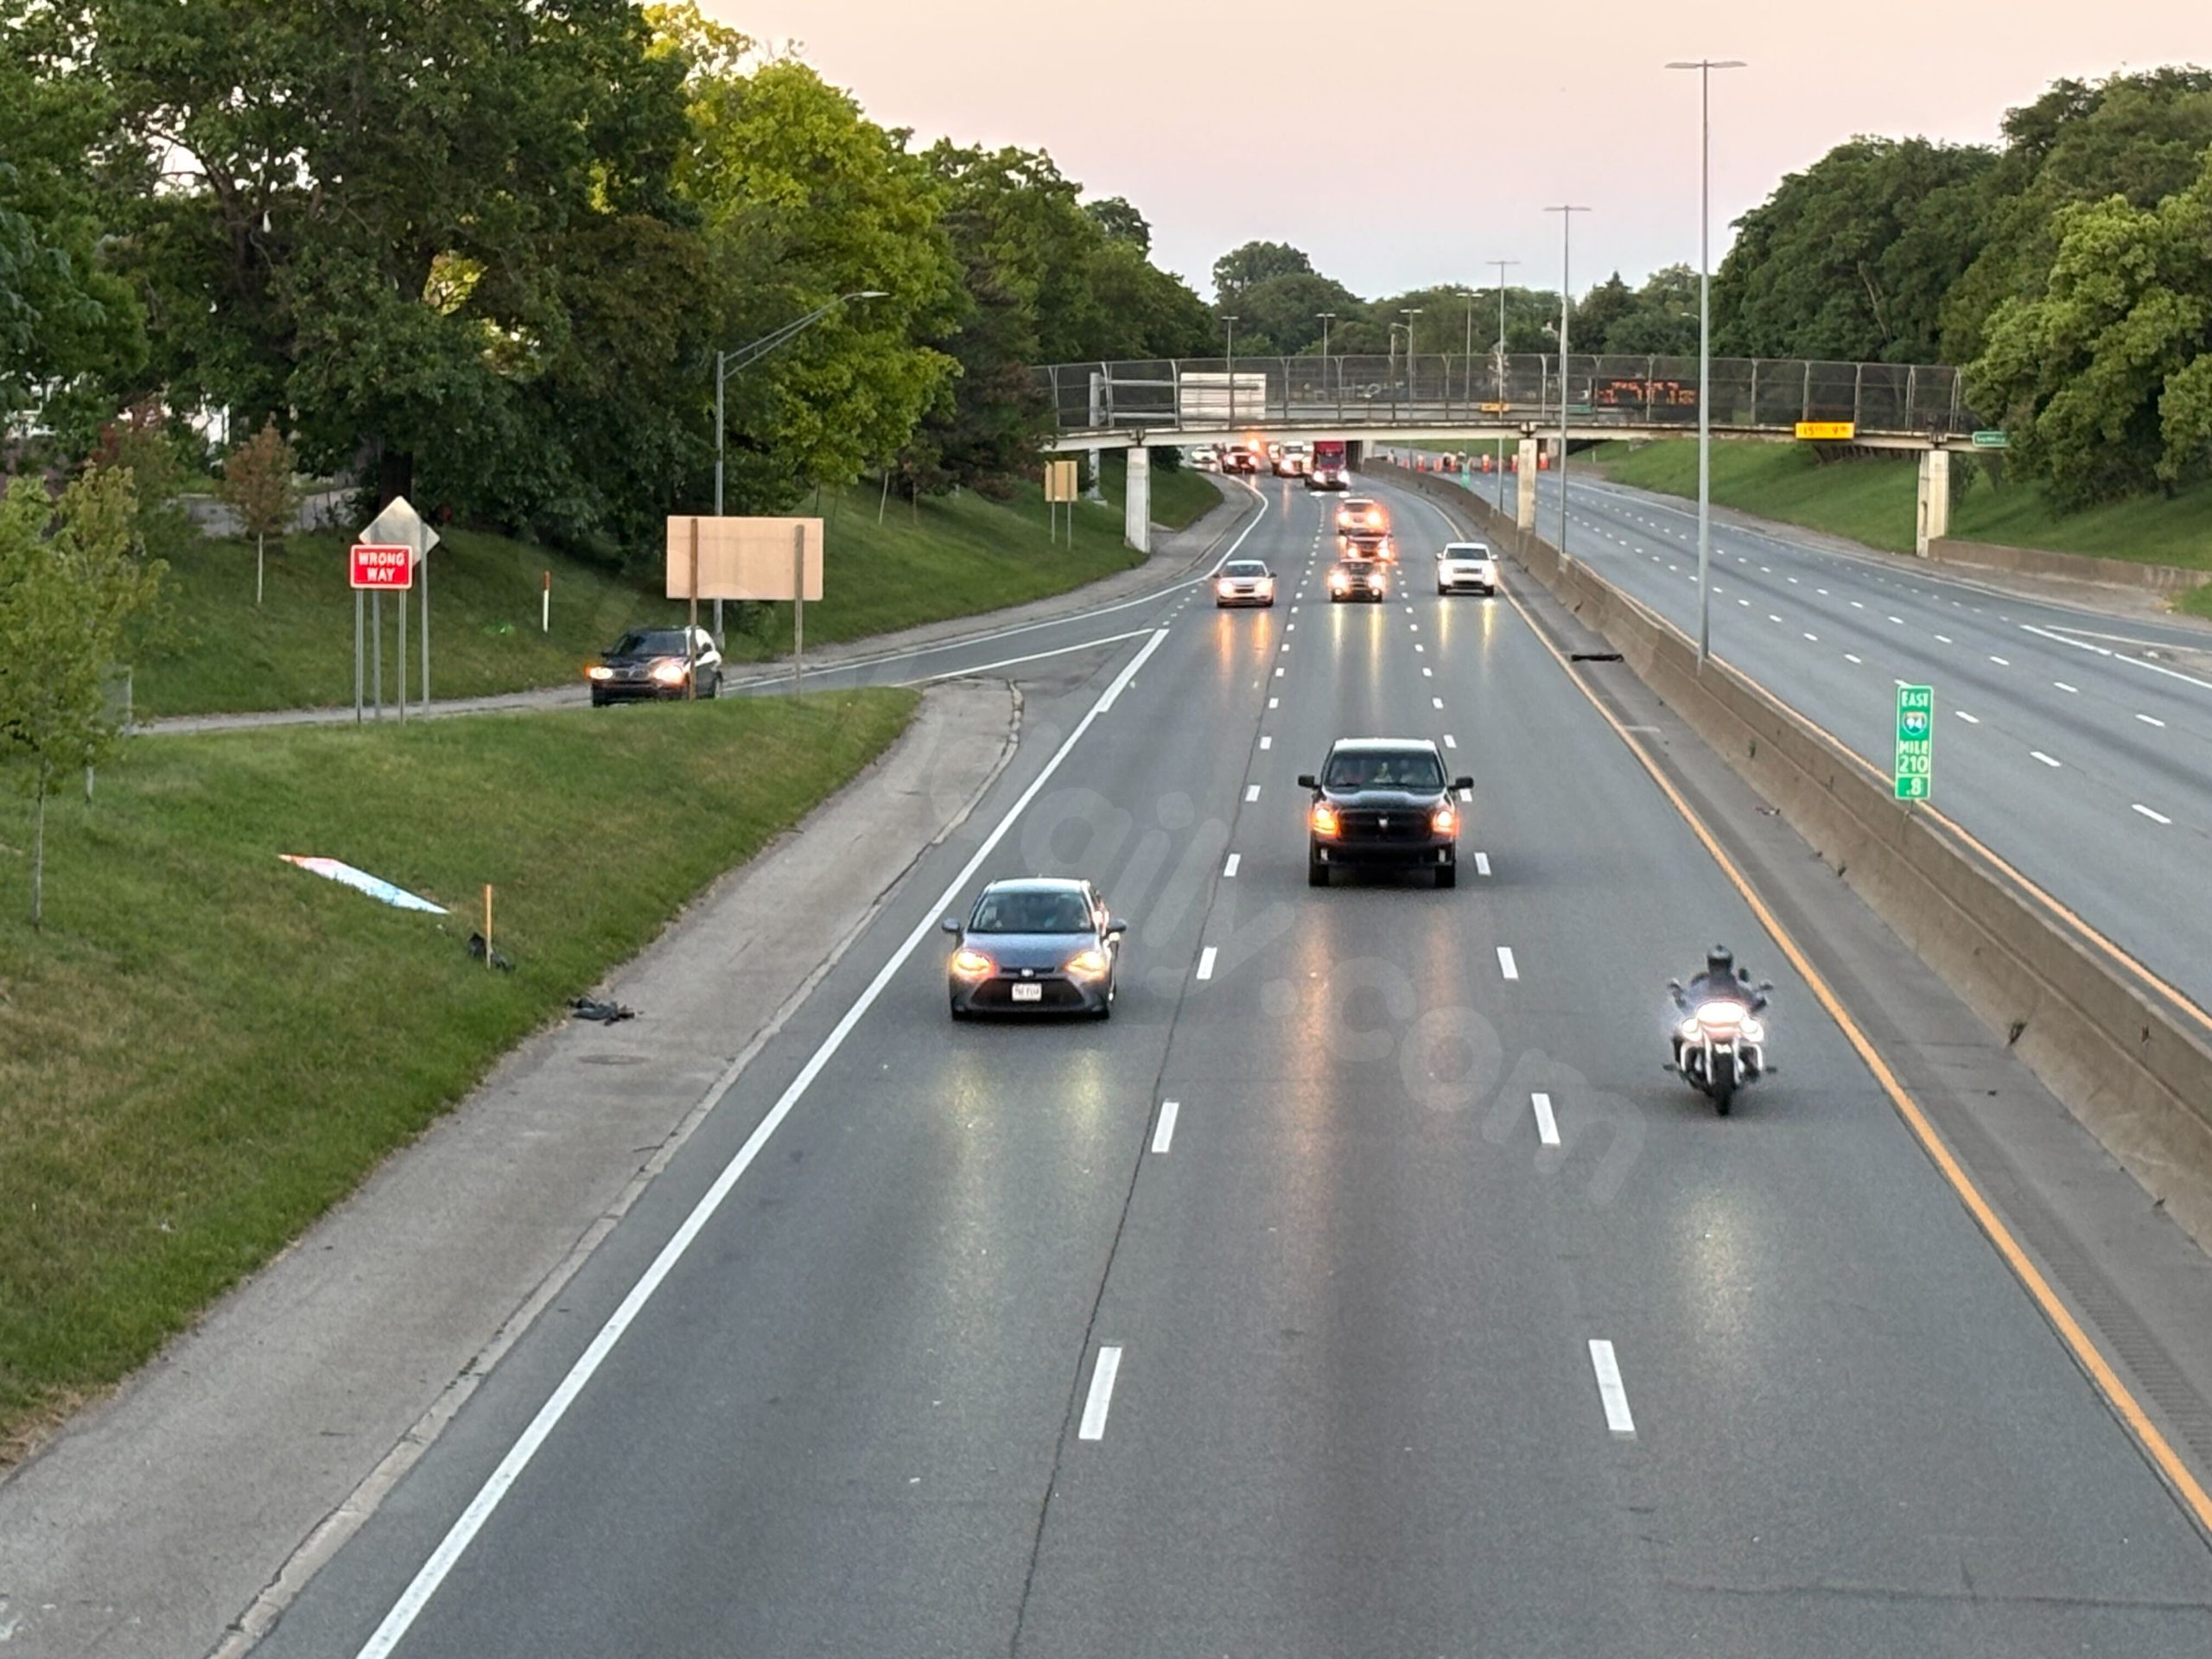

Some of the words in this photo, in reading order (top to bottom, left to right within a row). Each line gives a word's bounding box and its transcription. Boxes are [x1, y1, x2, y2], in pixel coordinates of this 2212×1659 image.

[358, 551, 405, 566] WRONG
[366, 567, 396, 582] WAY
[1901, 690, 1929, 707] EAST
[1906, 717, 1923, 729] 94
[1899, 740, 1929, 755] MILE
[1899, 755, 1929, 773] 210
